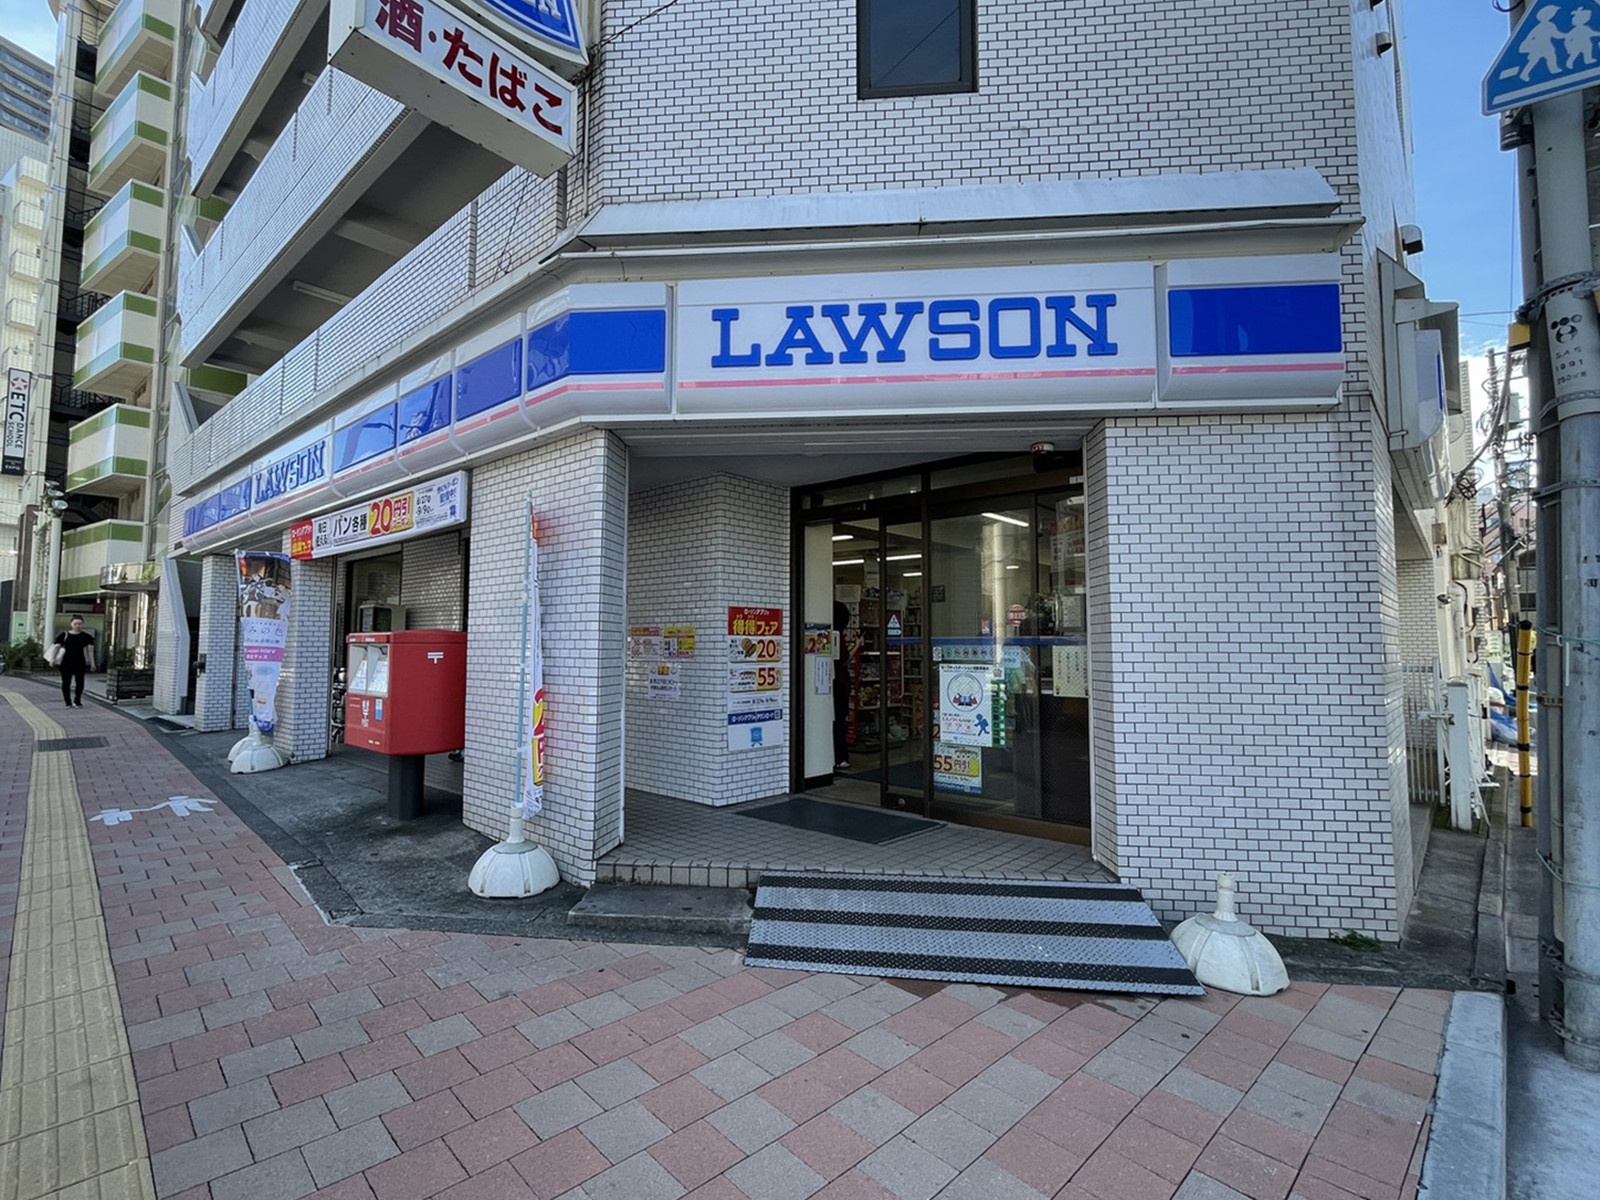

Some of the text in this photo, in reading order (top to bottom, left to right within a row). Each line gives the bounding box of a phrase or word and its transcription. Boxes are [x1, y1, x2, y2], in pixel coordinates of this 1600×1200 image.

[711, 293, 1119, 368] LAWSON
[9, 391, 26, 422] ETC
[6, 421, 15, 448] SCHOOL
[14, 421, 24, 449] DANCE
[255, 441, 326, 504] LAWSON
[333, 512, 368, 537] パン各種
[757, 639, 776, 659] 20
[757, 666, 776, 687] 55
